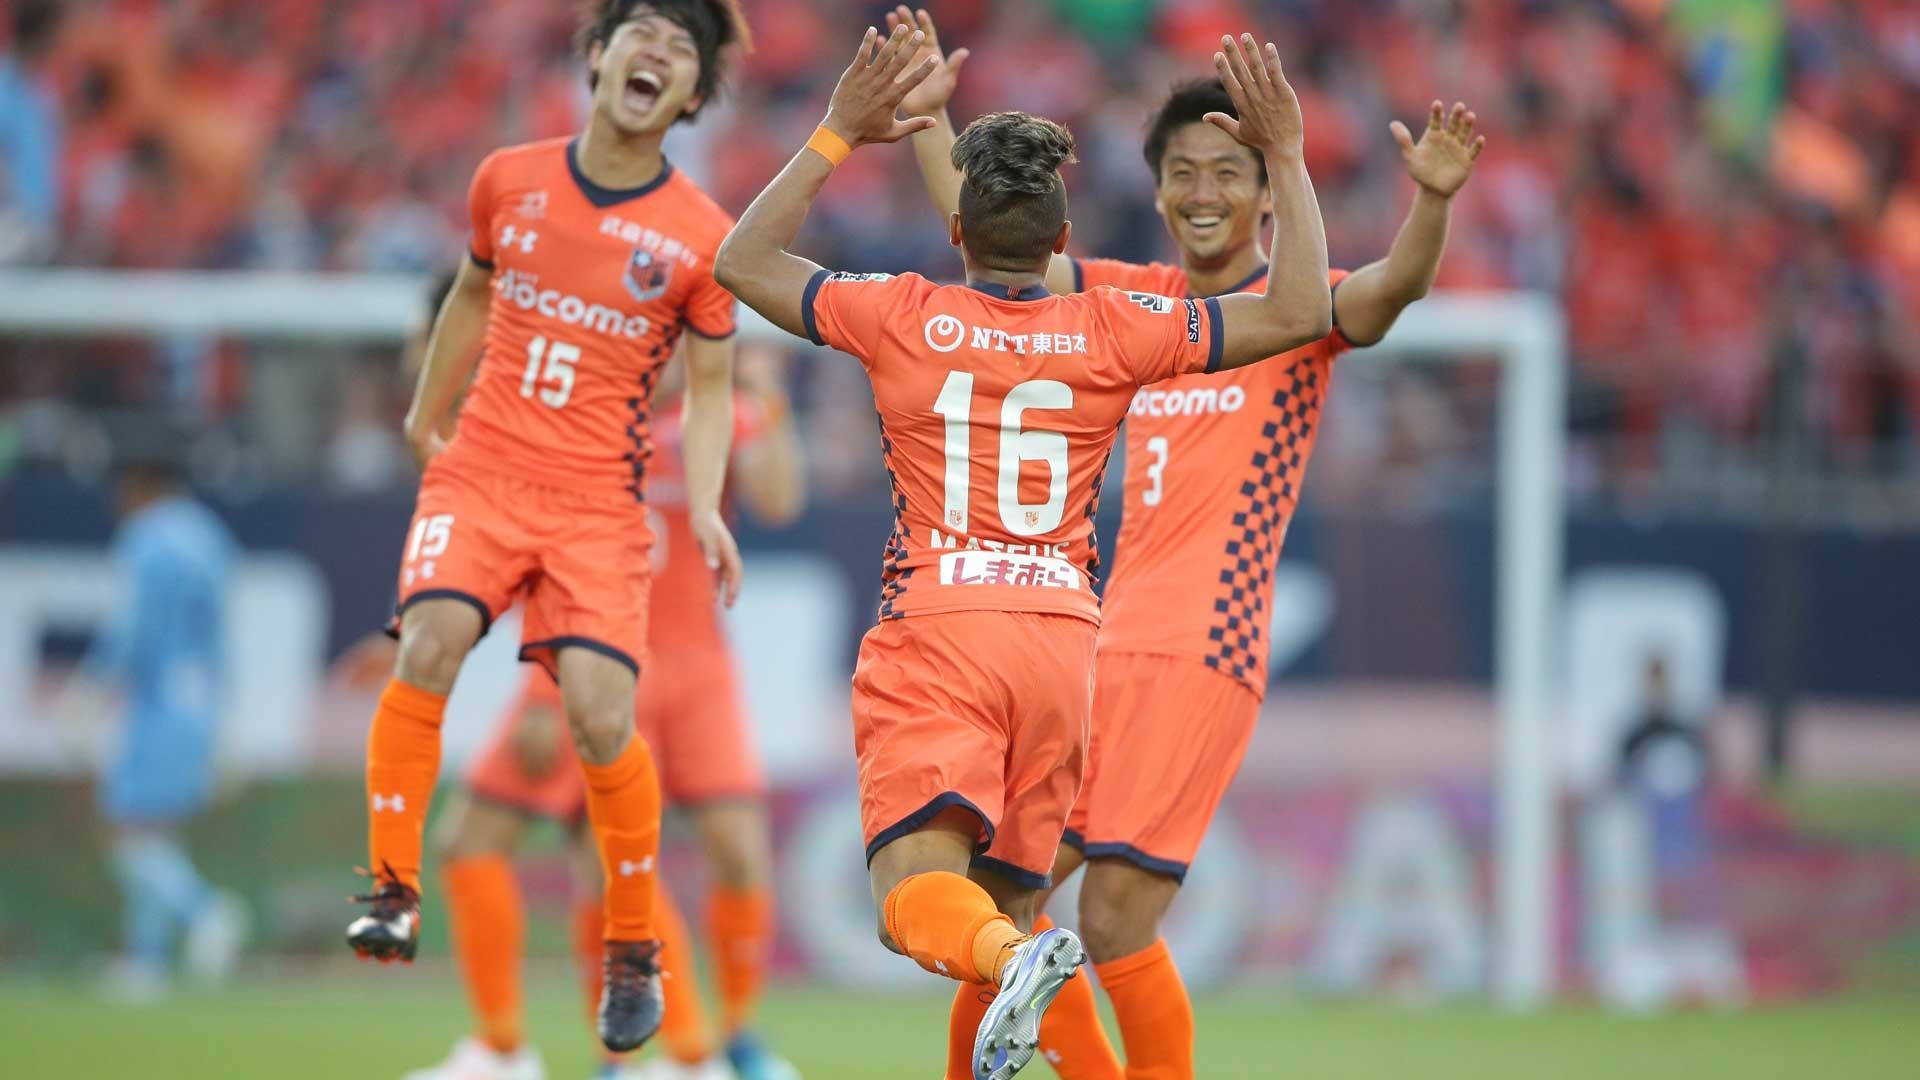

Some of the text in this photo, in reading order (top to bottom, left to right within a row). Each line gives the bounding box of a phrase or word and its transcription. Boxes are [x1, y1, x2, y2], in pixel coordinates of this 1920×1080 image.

[497, 268, 650, 338] docomo
[520, 334, 581, 409] 15
[933, 370, 1074, 537] 16
[1143, 436, 1169, 507] 3
[408, 514, 455, 563] 15
